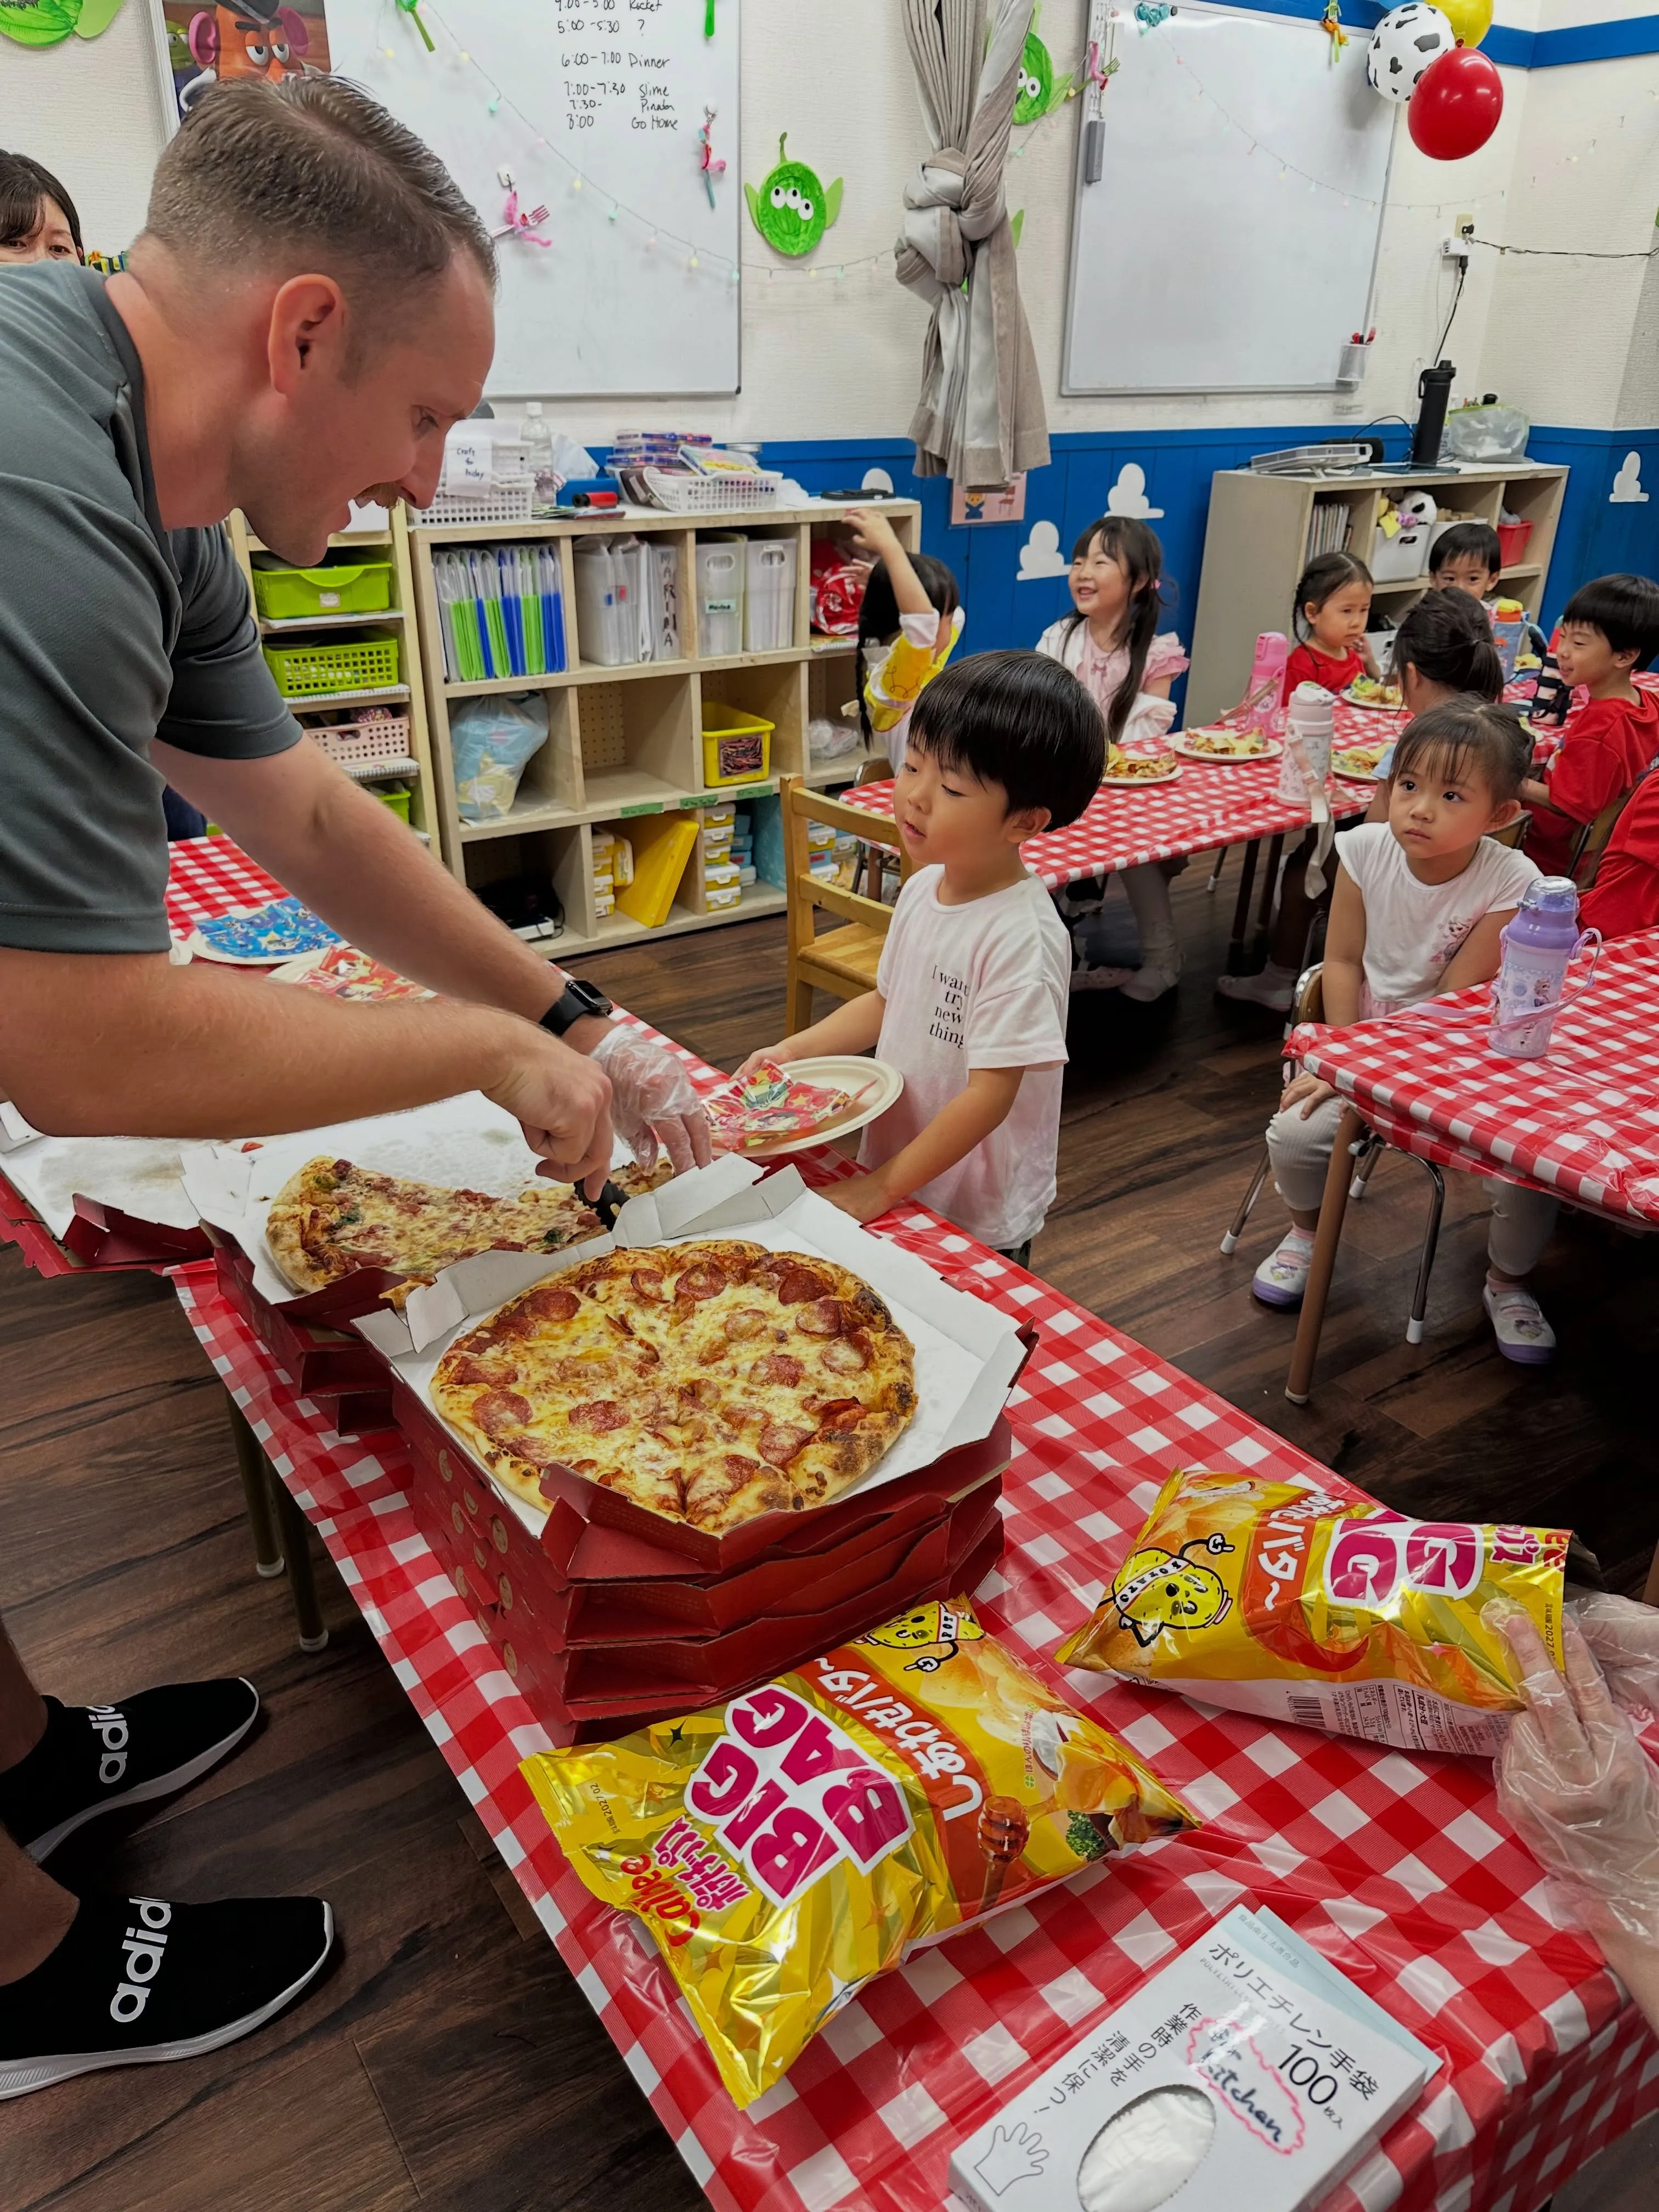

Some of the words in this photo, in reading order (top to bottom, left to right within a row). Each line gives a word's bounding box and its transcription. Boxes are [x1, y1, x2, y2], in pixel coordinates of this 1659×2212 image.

[628, 53, 670, 68] Dinner
[637, 19, 645, 36] ?
[567, 114, 594, 129] 8:00
[632, 117, 646, 129] Go
[652, 115, 678, 130] Home
[932, 965, 938, 979] I
[940, 972, 969, 997] want
[934, 1006, 963, 1024] new
[945, 990, 963, 1010] try
[732, 1689, 909, 1864] BAG
[691, 1742, 840, 1899] BIG
[620, 1853, 701, 1947] Calbee
[653, 1816, 752, 1911] ポテトチップス
[110, 1895, 172, 2023] adid
[1110, 2002, 1202, 2087] 作業時の手を
[1209, 1942, 1379, 2101] ポリエチレン手袋
[1278, 2044, 1339, 2106] 100
